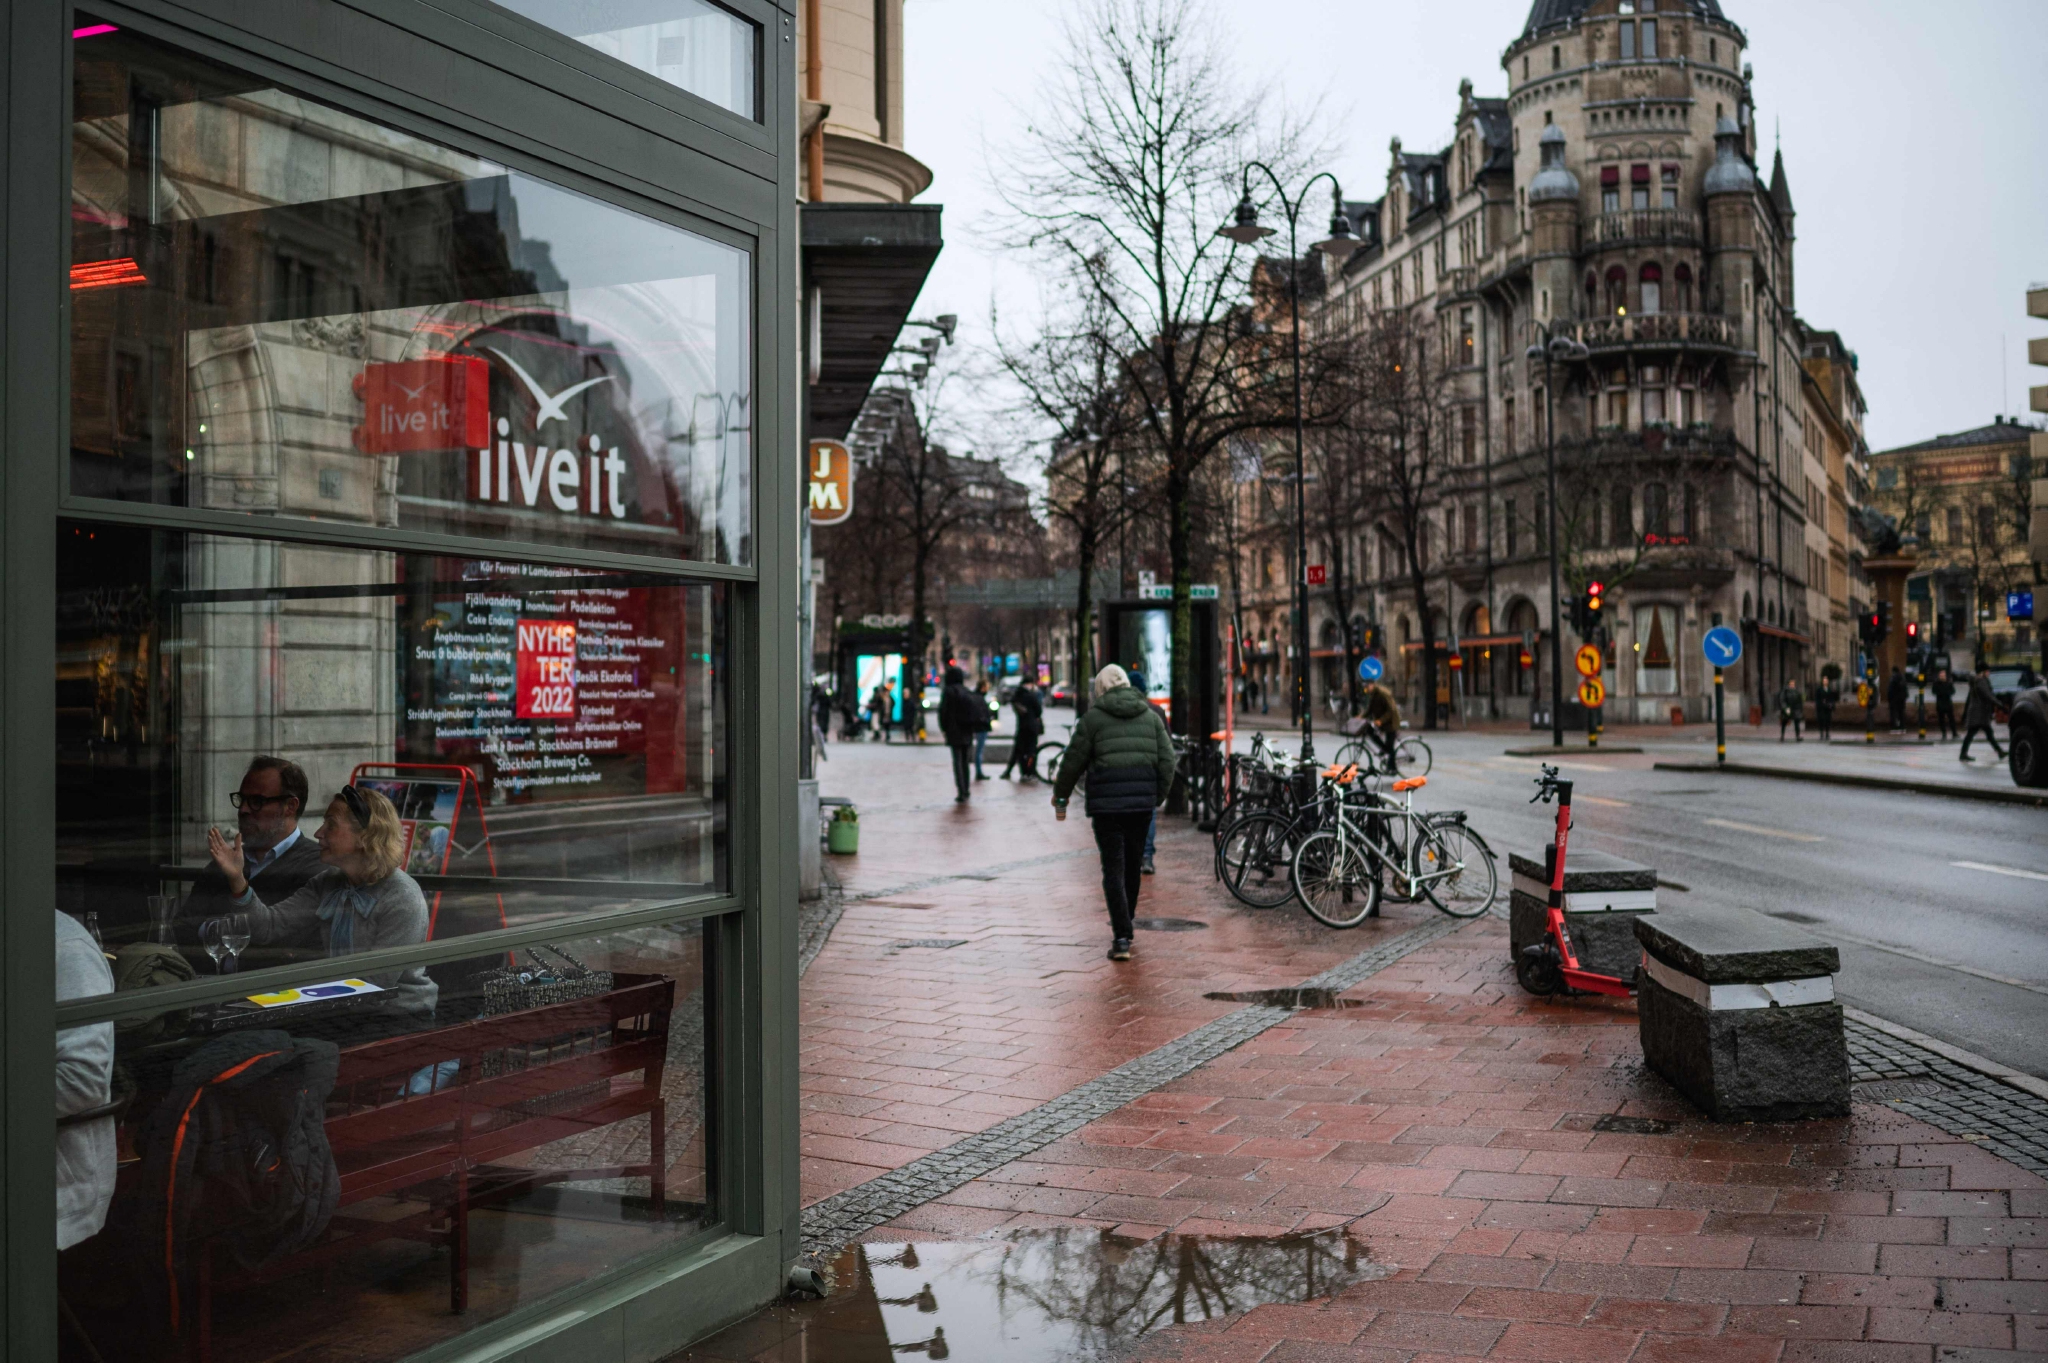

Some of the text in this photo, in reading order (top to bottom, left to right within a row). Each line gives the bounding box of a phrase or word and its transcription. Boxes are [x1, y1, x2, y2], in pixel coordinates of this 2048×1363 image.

[381, 401, 450, 435] live it
[479, 415, 626, 518] live it
[480, 561, 494, 573] Kör
[495, 562, 520, 575] Ferrari
[465, 593, 521, 610] Fjällvandring
[570, 600, 616, 614] Padellektion
[467, 613, 514, 626] Cake Enduro
[434, 628, 508, 644] Ångbåtsmusik Deluxe
[518, 625, 573, 652] NYHE
[576, 633, 603, 645] Mathias
[637, 636, 665, 648] Klassiker
[416, 645, 436, 659] Snus
[446, 646, 511, 665] bubbelprovning
[536, 656, 574, 683] TER
[575, 670, 599, 683] Besök
[485, 673, 514, 687] Bryggeri
[531, 686, 573, 713] 2022
[407, 706, 512, 722] Stridsflygsimulator Stockholm
[580, 704, 615, 716] Vinterbad
[492, 725, 503, 736] Spa
[504, 725, 530, 736] Boutique
[481, 742, 498, 753] Lash
[507, 740, 535, 752] Browlift
[539, 737, 618, 752] Stockholms Bränneri
[497, 754, 592, 772] Stockholm Brewing Co.
[493, 771, 602, 789] Stridsflygsimulator med stridspilot
